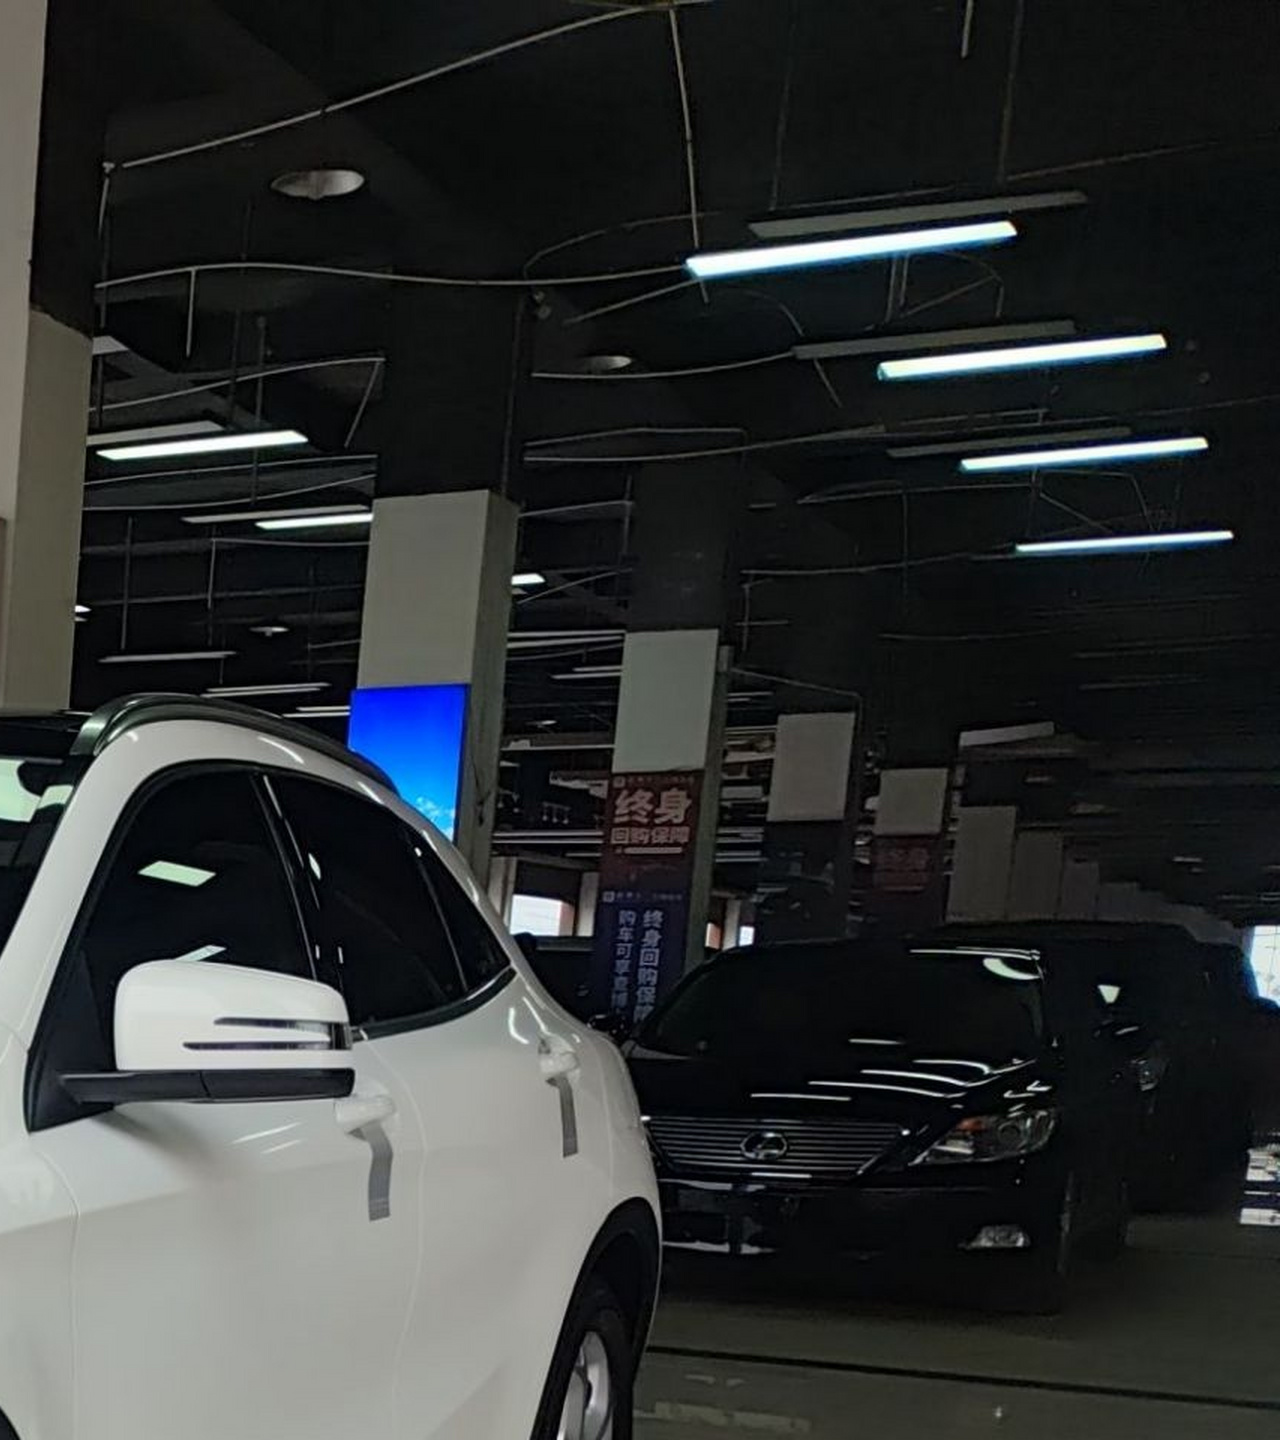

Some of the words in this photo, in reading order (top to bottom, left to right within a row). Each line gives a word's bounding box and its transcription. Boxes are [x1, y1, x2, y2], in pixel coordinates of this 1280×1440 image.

[614, 787, 692, 824] 终身
[610, 826, 690, 844] 回购保障
